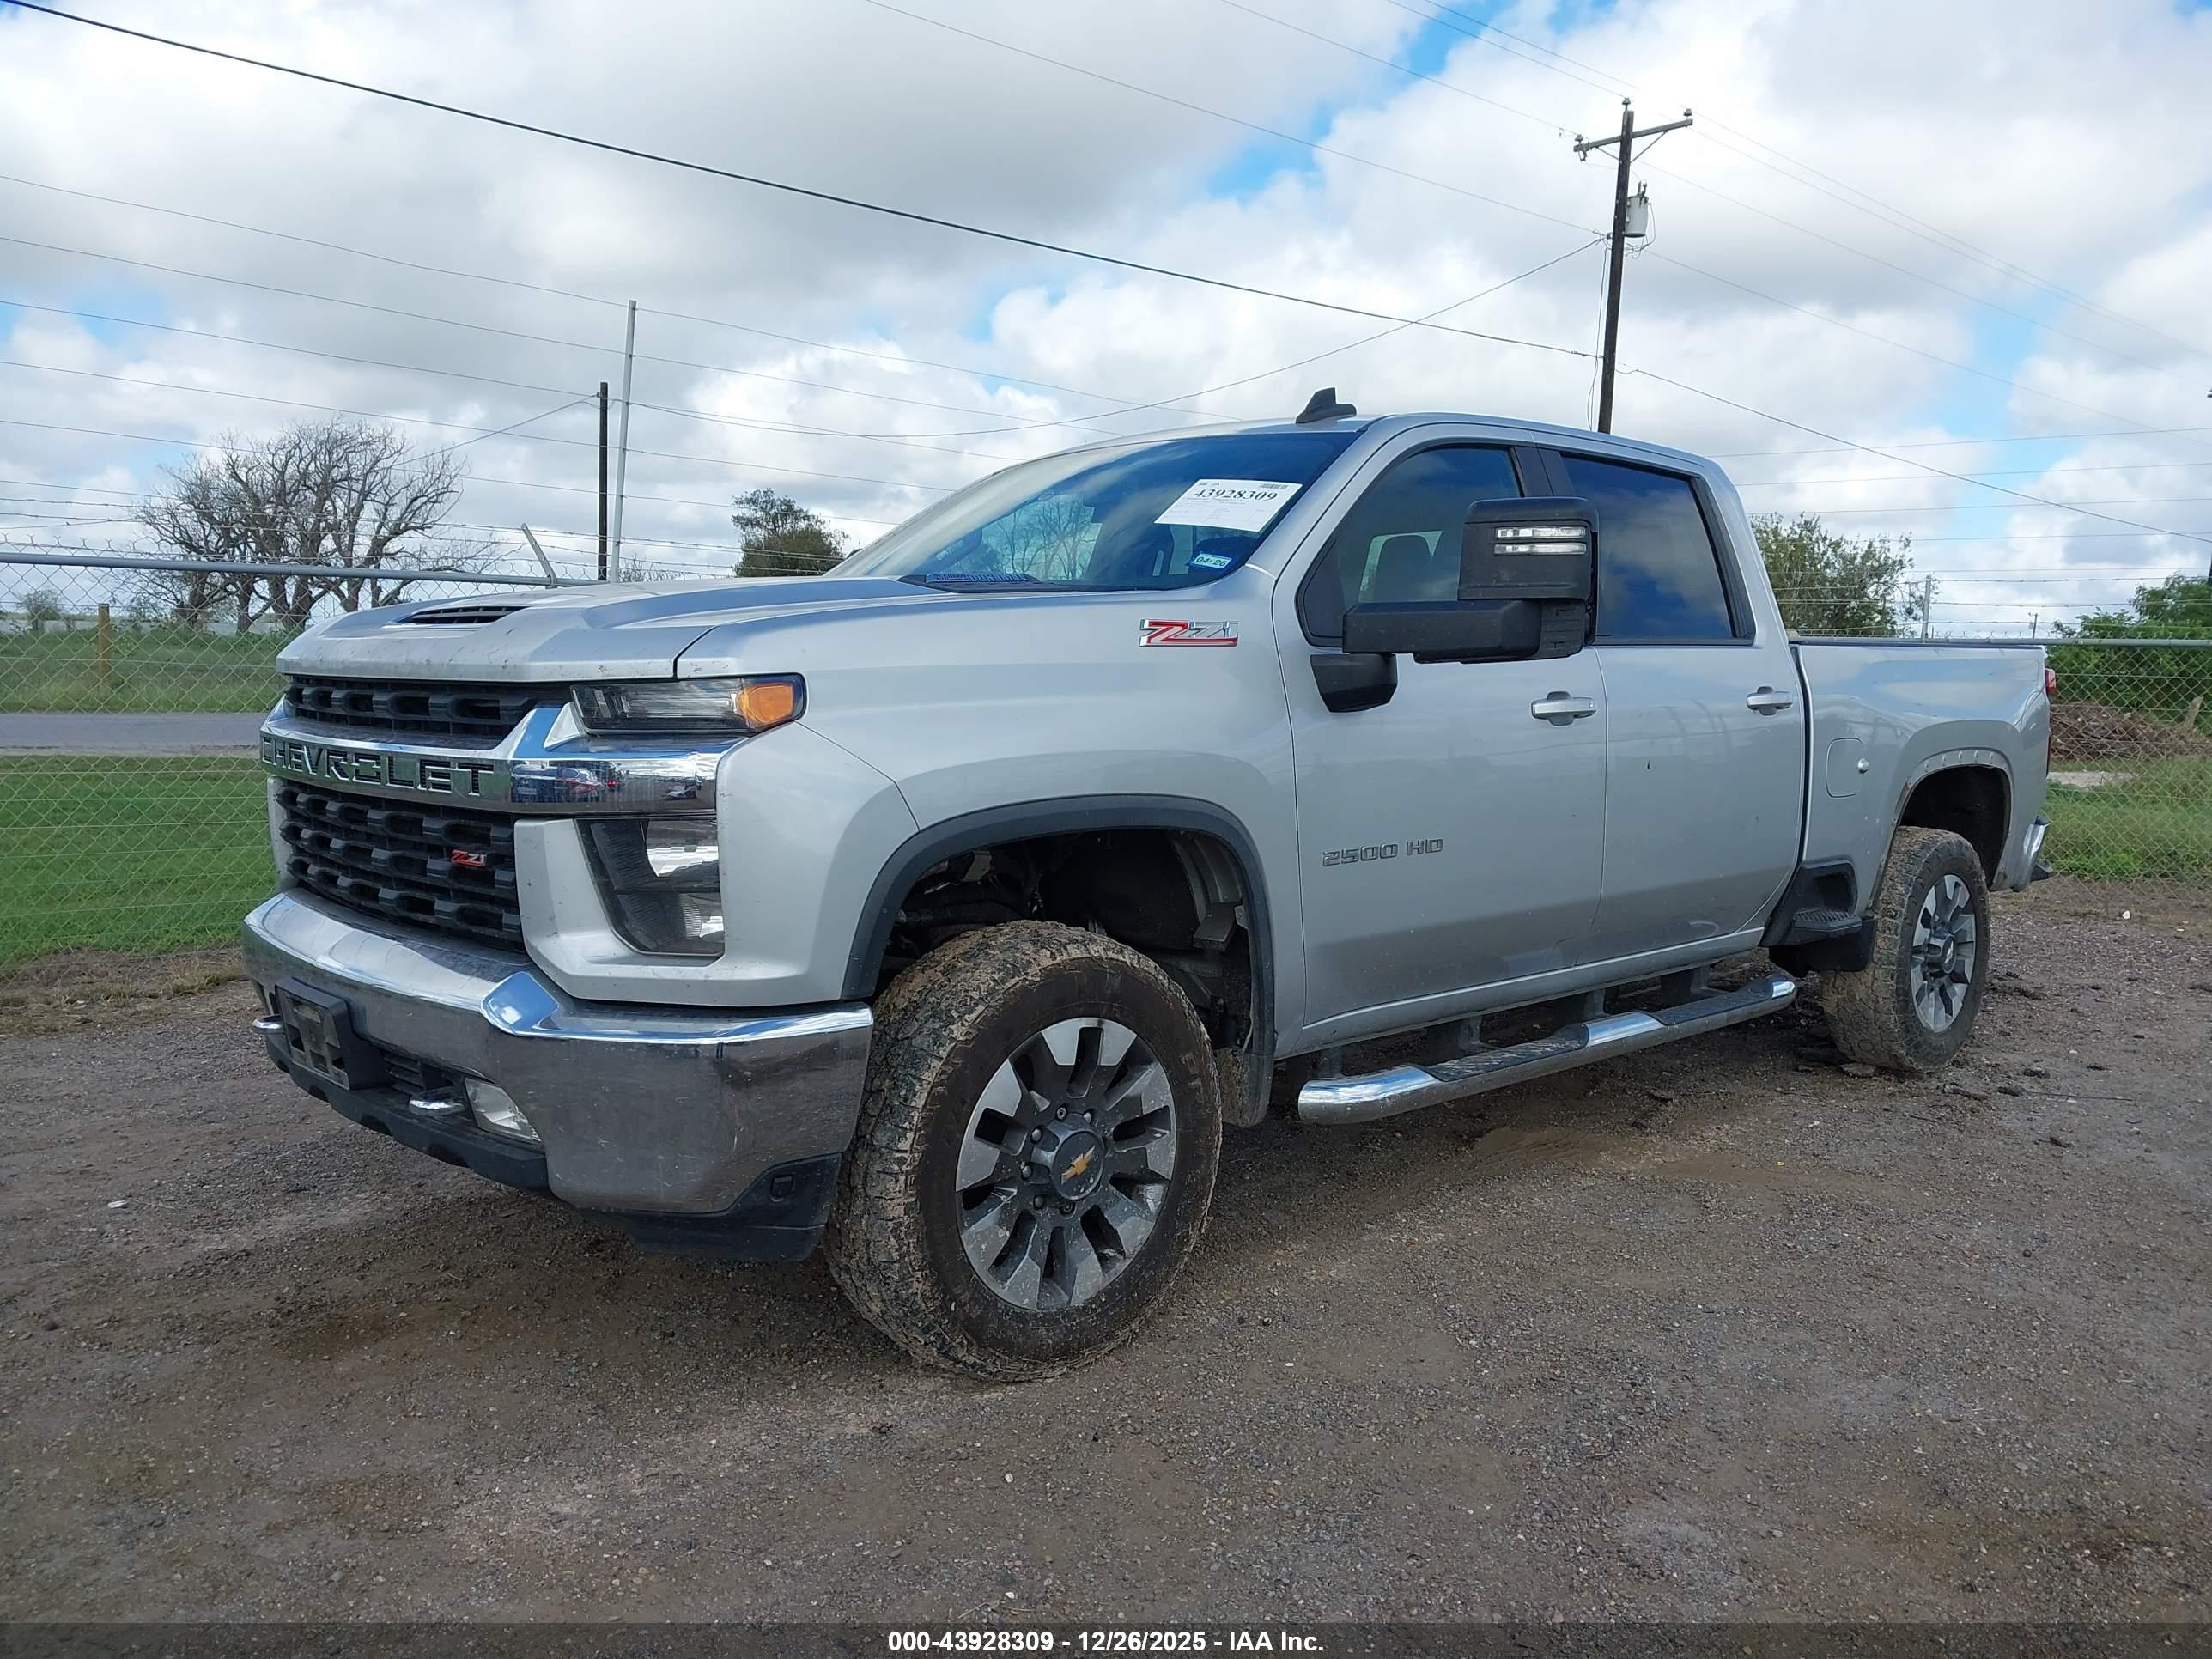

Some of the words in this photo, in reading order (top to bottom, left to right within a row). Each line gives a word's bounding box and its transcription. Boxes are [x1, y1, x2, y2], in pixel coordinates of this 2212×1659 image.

[1194, 489, 1278, 501] 43928309
[1139, 618, 1238, 647] Z71
[262, 736, 495, 797] CHEVROLET
[452, 849, 488, 867] Z71
[1323, 843, 1398, 866] 2500
[1406, 838, 1443, 856] HD
